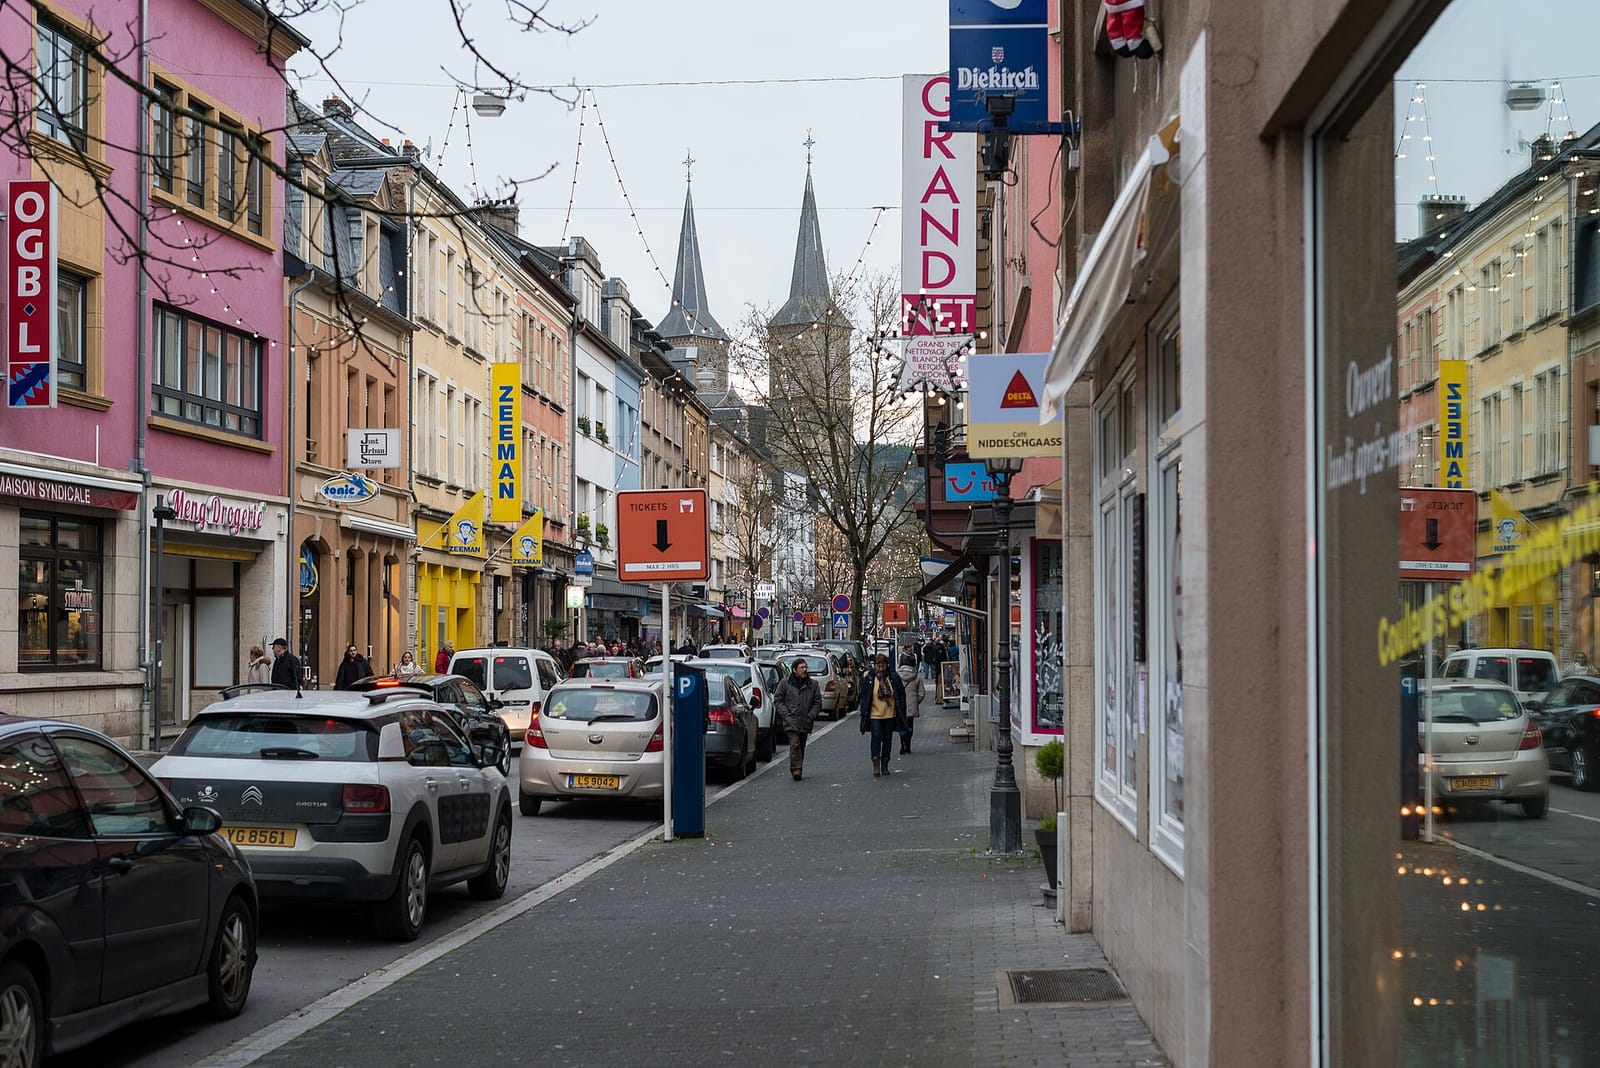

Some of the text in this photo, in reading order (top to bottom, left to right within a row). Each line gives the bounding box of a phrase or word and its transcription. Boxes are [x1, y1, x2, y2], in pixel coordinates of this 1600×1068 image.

[957, 64, 1039, 91] Diekirch
[920, 76, 961, 289] GRAND
[903, 297, 974, 333] NET
[1007, 392, 1032, 401] DELTA
[497, 385, 515, 499] ZEEMAN
[978, 437, 1062, 448] NIDDESCHGAASS
[39, 481, 91, 504] SYNDICALE
[324, 484, 355, 495] tonic
[169, 489, 263, 536] Meng Drogerie
[629, 502, 668, 512] TICKETS
[449, 545, 481, 554] ZEEMAN
[680, 676, 691, 695] P
[577, 776, 615, 786] LS 9042
[227, 829, 286, 845] YG 8561
